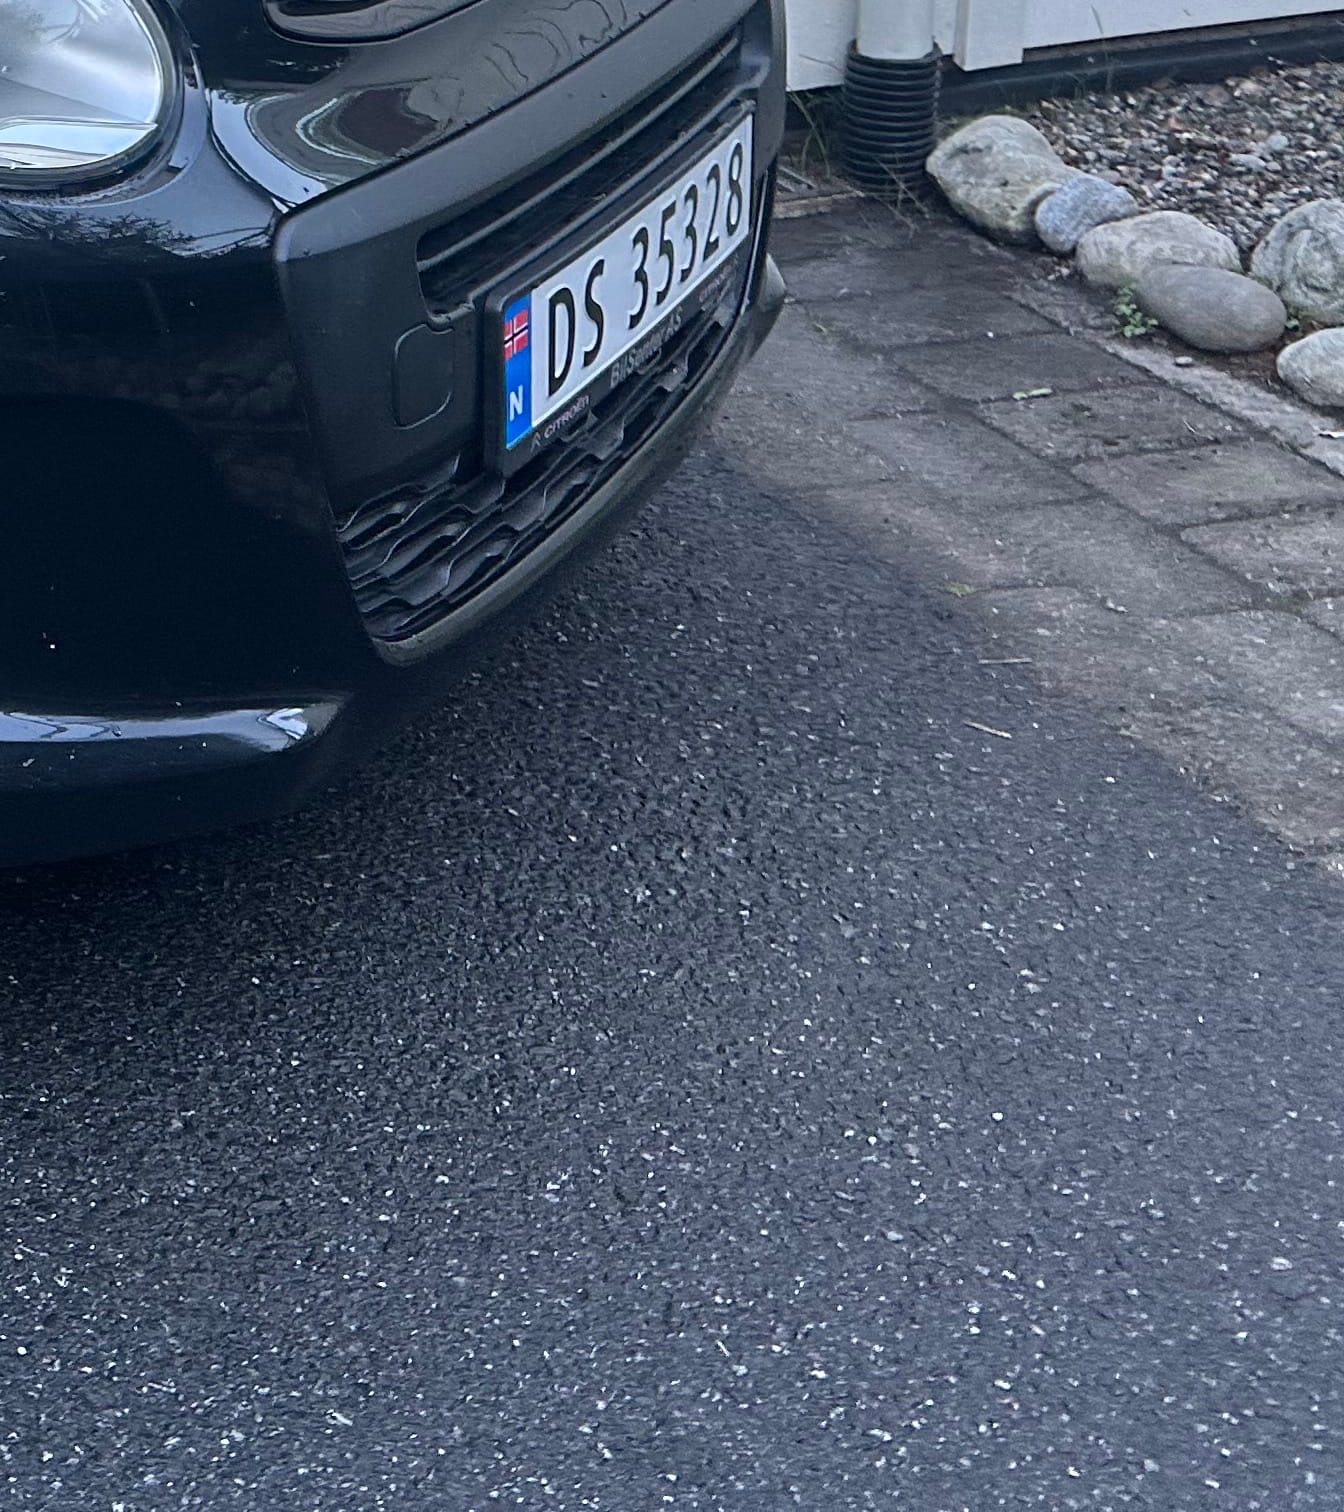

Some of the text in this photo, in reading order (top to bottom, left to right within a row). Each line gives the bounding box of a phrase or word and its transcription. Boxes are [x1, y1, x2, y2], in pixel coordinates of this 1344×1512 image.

[547, 141, 743, 397] DS 35328
[509, 386, 524, 422] N
